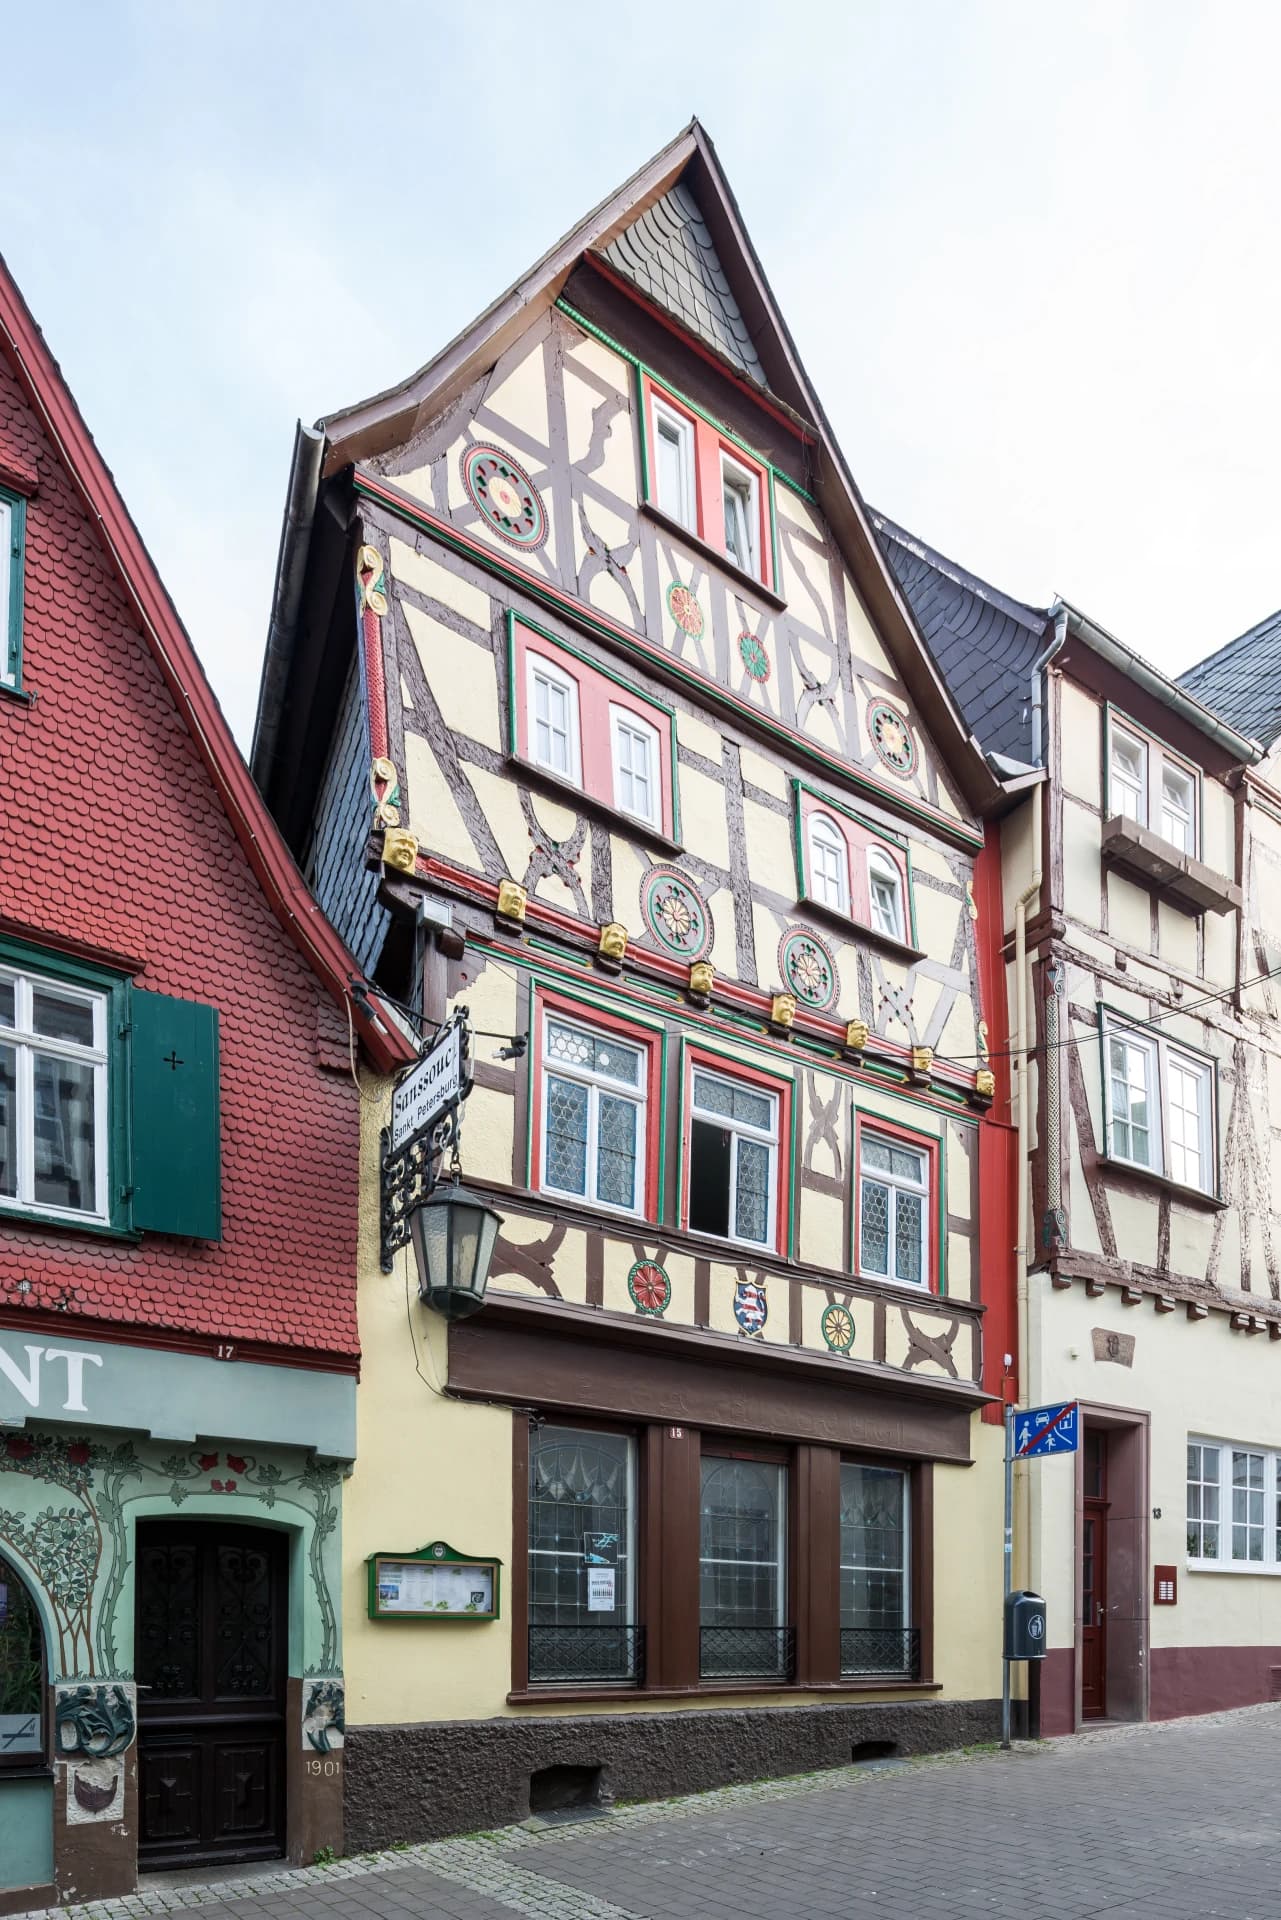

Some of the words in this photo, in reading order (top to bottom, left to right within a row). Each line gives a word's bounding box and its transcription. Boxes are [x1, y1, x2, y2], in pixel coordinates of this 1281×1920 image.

[395, 1045, 457, 1119] Sanssouc
[394, 1116, 414, 1141] Sankt
[417, 1074, 458, 1120] Petersburg
[218, 1345, 234, 1359] 17
[671, 1426, 682, 1439] 15
[1152, 1506, 1162, 1520] 13
[305, 1760, 340, 1777] 1901
